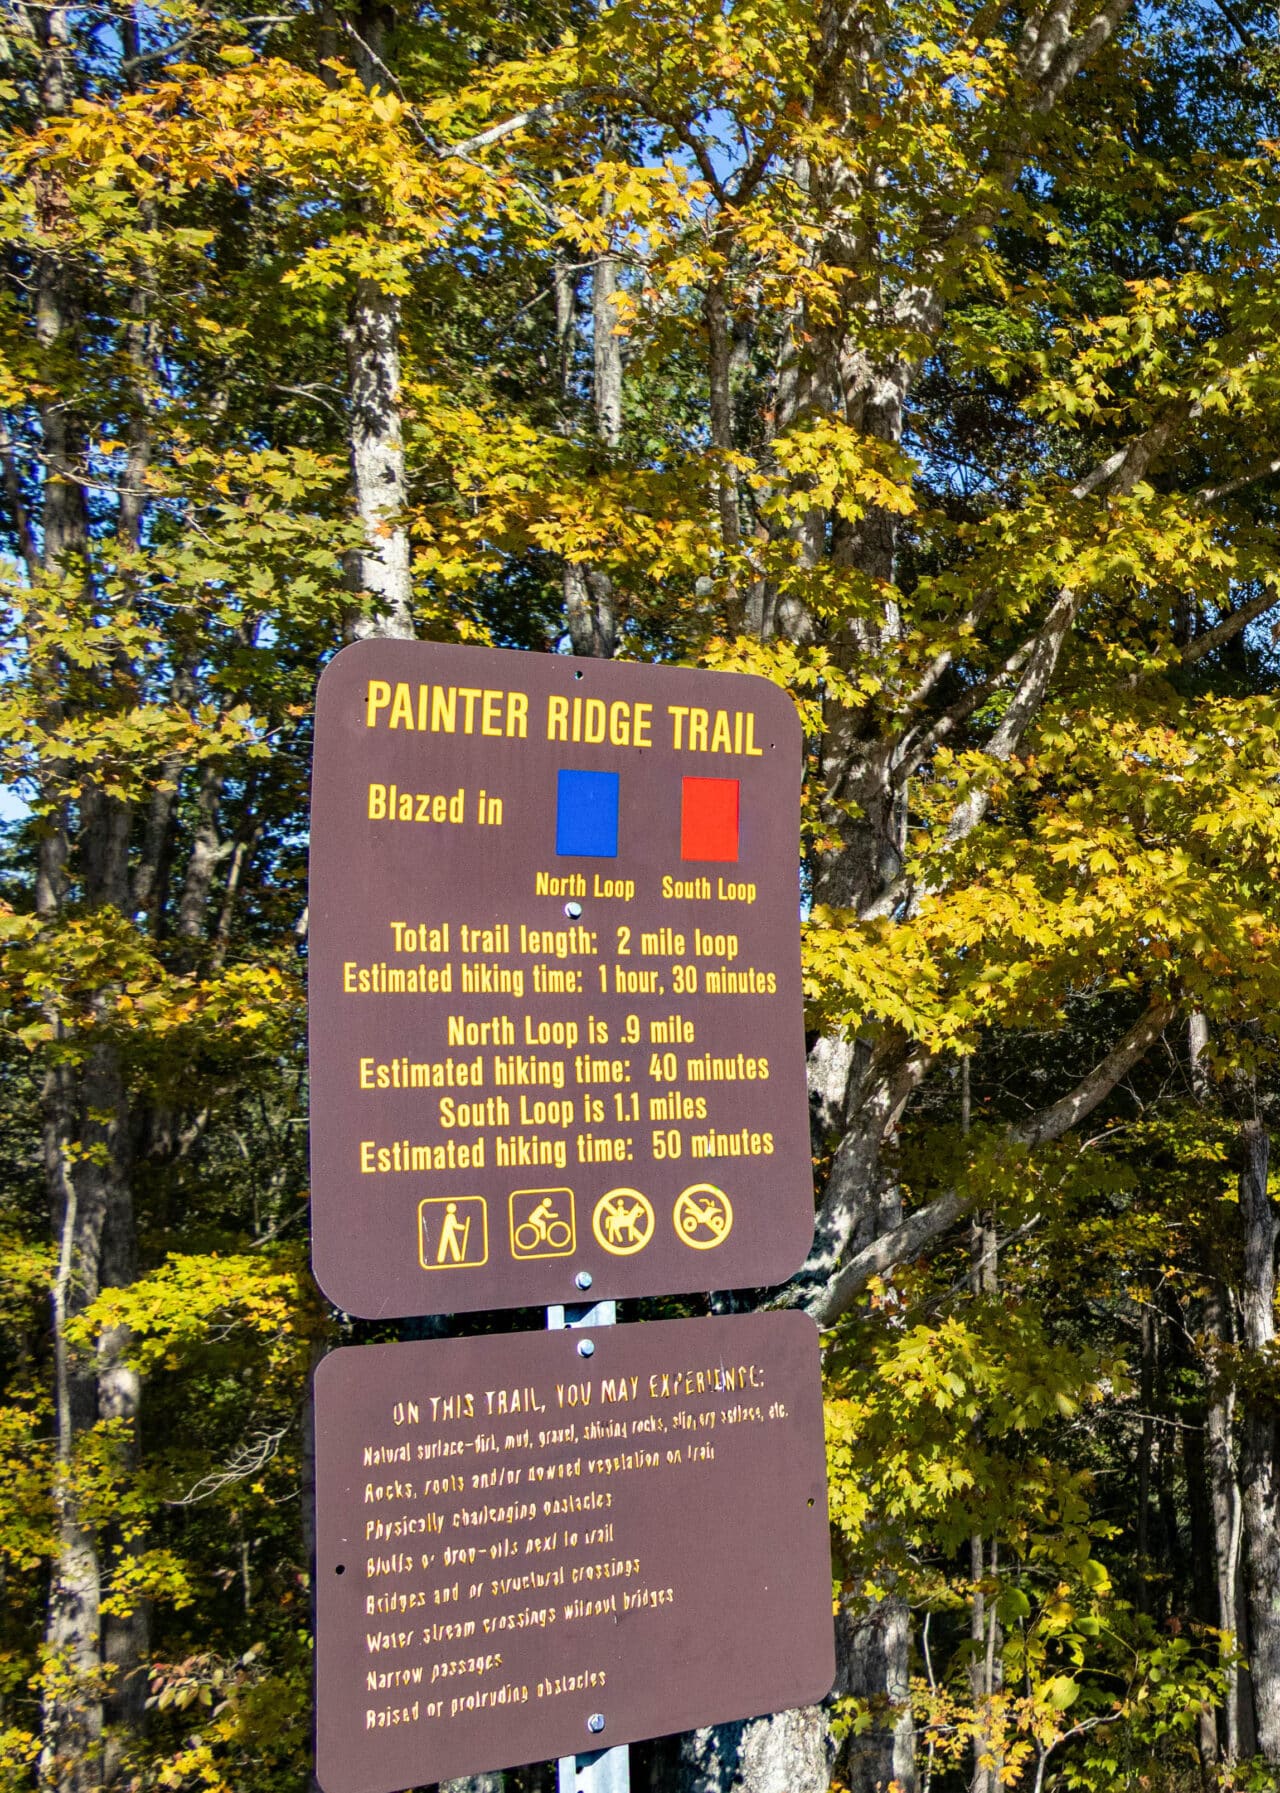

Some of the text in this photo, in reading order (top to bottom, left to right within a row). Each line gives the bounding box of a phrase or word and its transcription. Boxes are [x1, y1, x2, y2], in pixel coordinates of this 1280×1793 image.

[365, 679, 764, 757] PAINTER RIDGE TRAIL
[367, 783, 503, 826] Blazed in
[535, 871, 635, 902] North Loop
[661, 875, 757, 905] South Loop
[389, 921, 739, 962] Total trail length: 2 mile loop
[343, 961, 777, 999] Estimated hiking time: 1 hour, 30 minutes
[447, 1014, 695, 1050] North Loop is .9 mile
[359, 1052, 770, 1090] Estimated hiking time: 40 minutes
[438, 1090, 708, 1129] South Loop is 1.1 miles
[359, 1127, 775, 1174] Estimated hiking time: 50 minutes
[393, 1364, 765, 1426] ON THIS TRAIL, YOU MAY EXPERIENCE:
[363, 1441, 412, 1467] Natural
[504, 1428, 534, 1450] mud,
[538, 1423, 579, 1448] gravel,
[631, 1414, 668, 1435] rocks,
[672, 1410, 716, 1431] slipery
[768, 1401, 789, 1420] etc.
[364, 1479, 417, 1504] Rocks,
[424, 1474, 465, 1496] roots
[471, 1466, 522, 1489] and/or
[587, 1449, 660, 1475] vegetation
[666, 1449, 682, 1464] on
[365, 1490, 612, 1541] Physically challenging obstacles
[524, 1531, 557, 1555] next
[366, 1557, 640, 1616] Bridges and or structural crossings
[366, 1630, 415, 1654] Water
[422, 1620, 476, 1645] stream
[482, 1607, 557, 1634] crossings
[623, 1587, 674, 1611] bridges
[365, 1653, 503, 1692] Narrow passages
[365, 1669, 606, 1731] Raised or protruding obstacles
